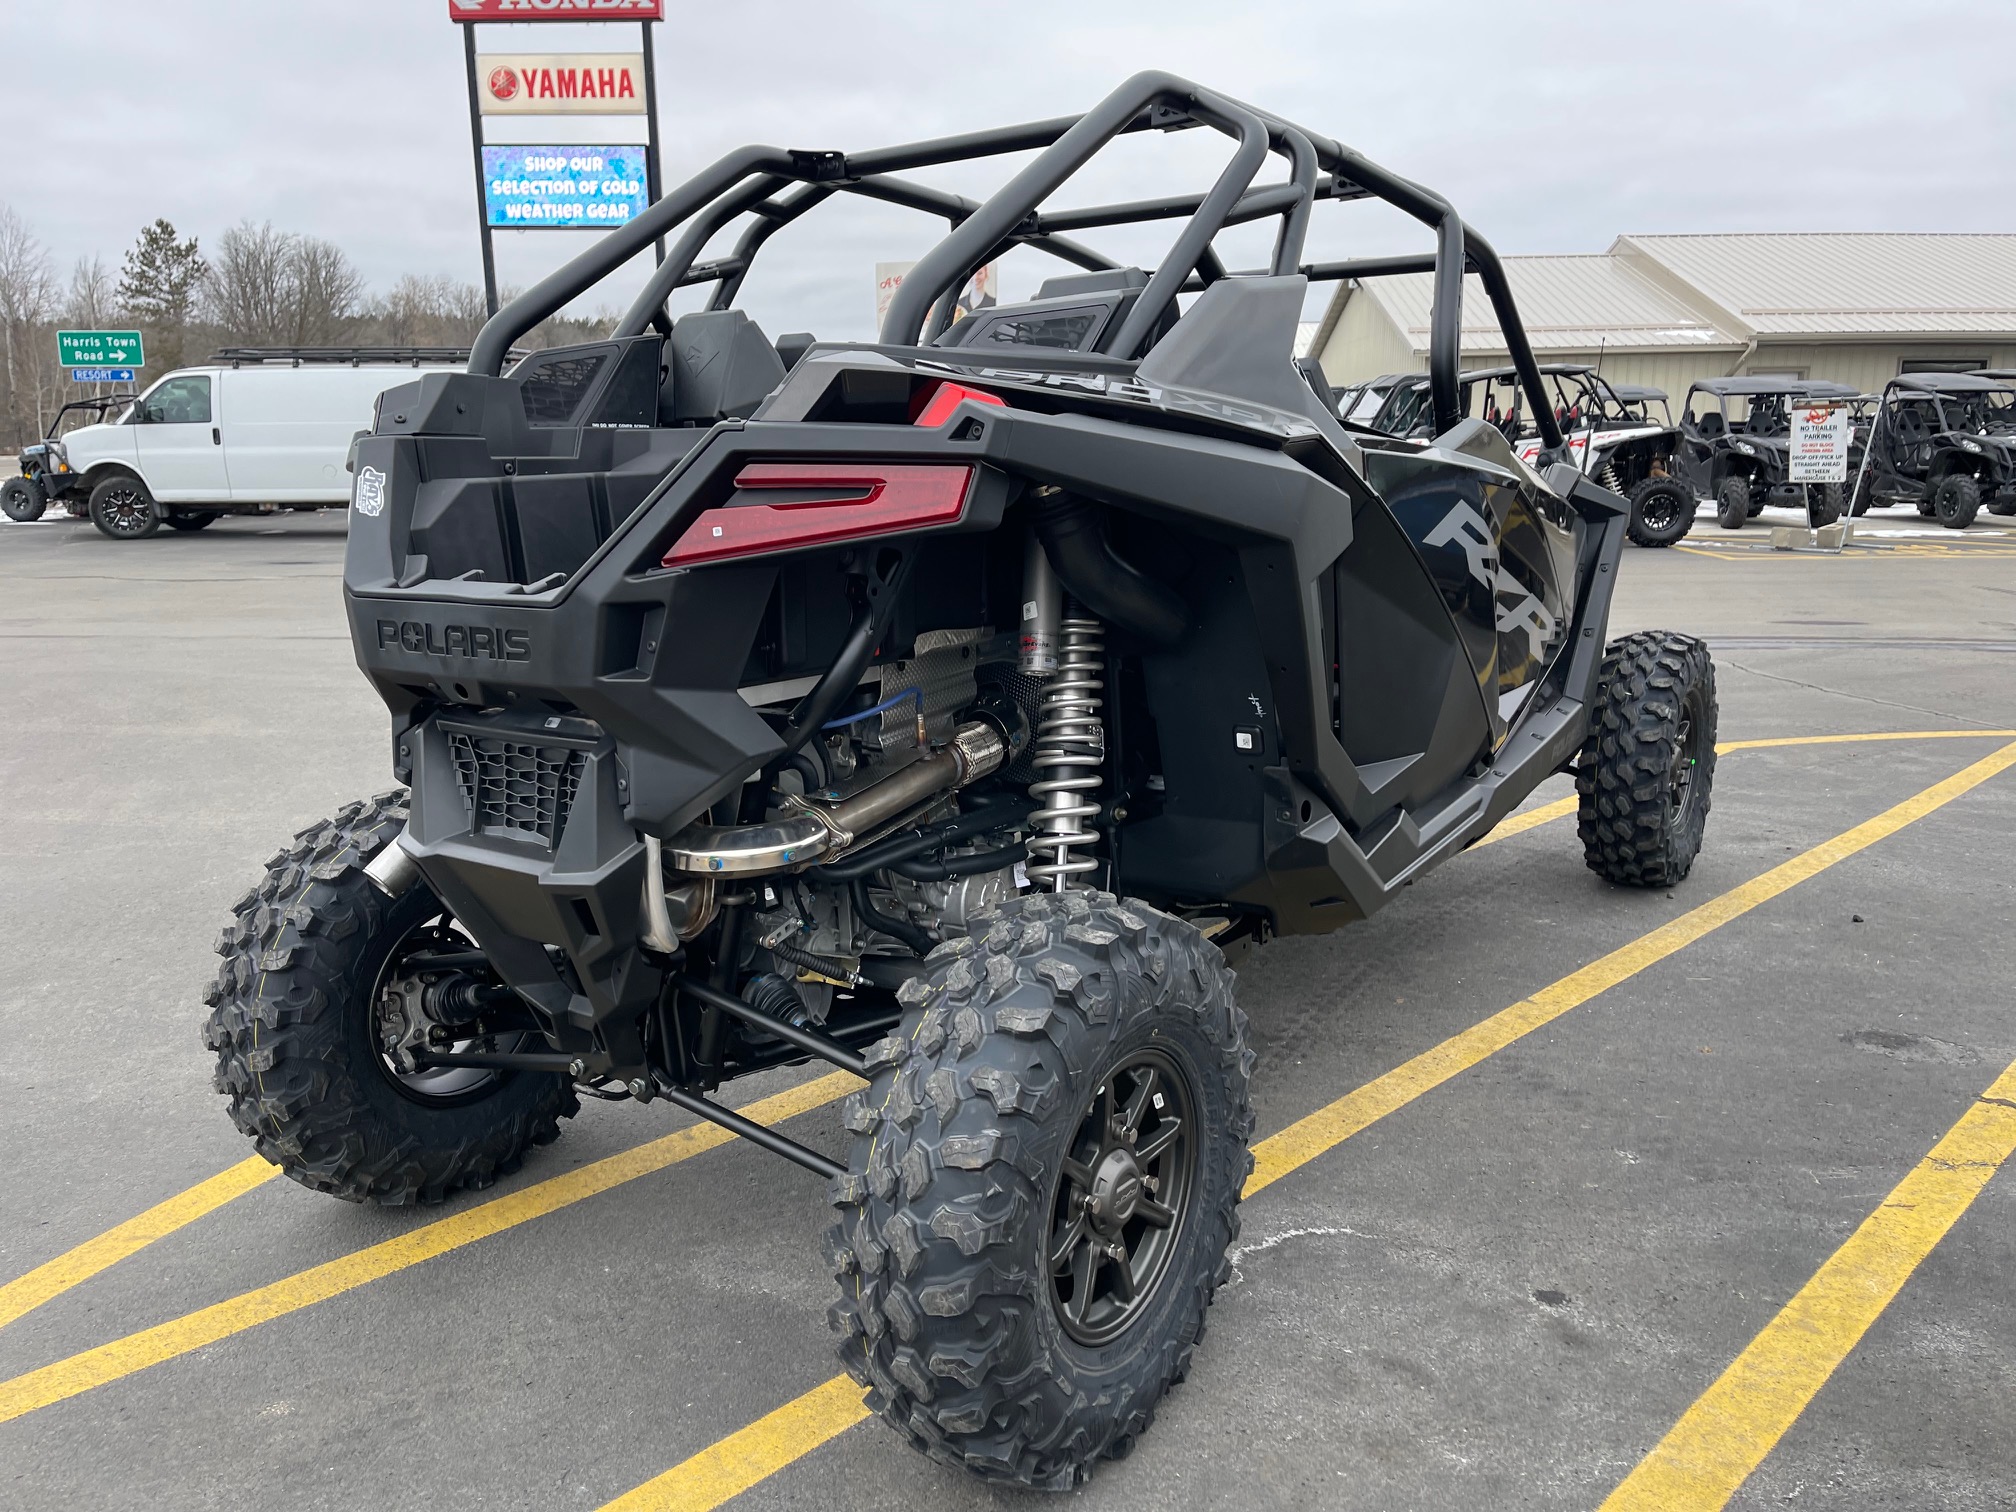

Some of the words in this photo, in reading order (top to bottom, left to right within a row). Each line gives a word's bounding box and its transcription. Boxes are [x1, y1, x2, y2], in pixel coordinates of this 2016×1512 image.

[521, 68, 635, 98] YAMAHA
[525, 156, 567, 172] SHOP
[570, 156, 603, 172] OUR
[491, 180, 576, 196] SELECTION
[578, 180, 599, 195] OF
[601, 180, 640, 196] COLD
[505, 203, 583, 219] WEATHER
[586, 203, 630, 219] GEAR
[63, 336, 101, 347] Harris
[106, 336, 137, 347] Town
[74, 350, 104, 361] Road
[75, 370, 112, 380] RESORT
[1422, 499, 1556, 666] RZR
[376, 619, 532, 663] POLARIS
